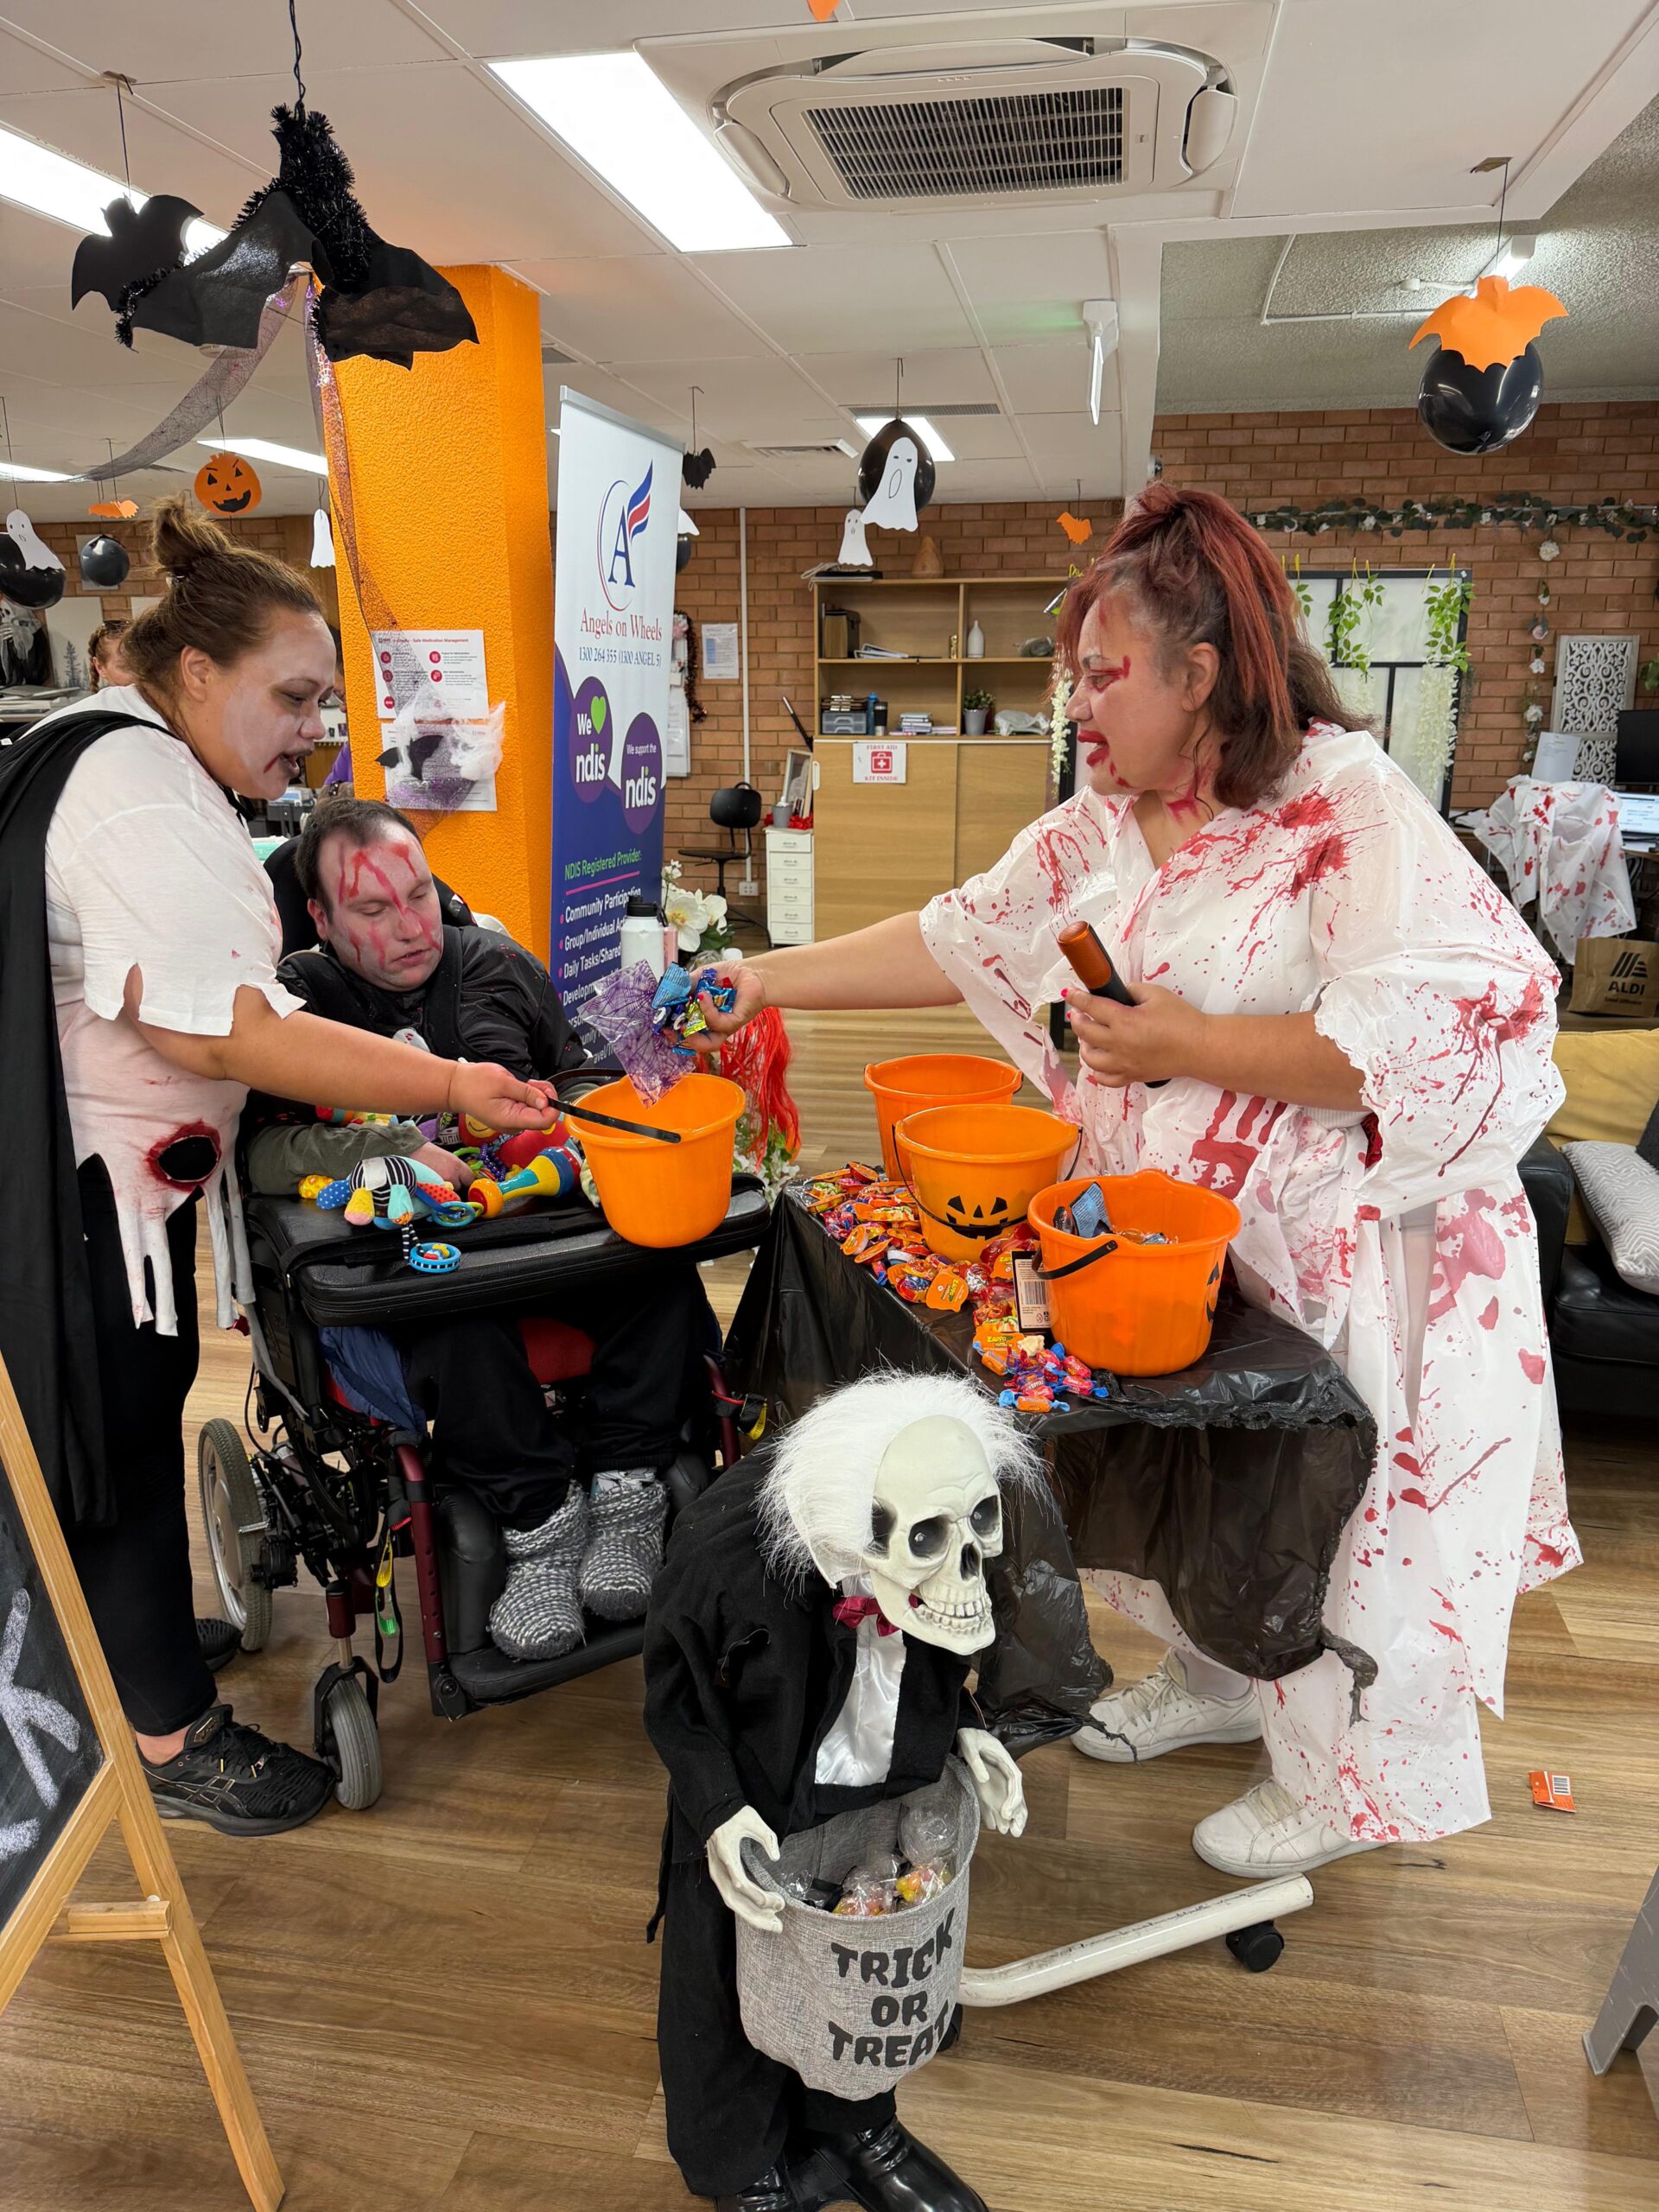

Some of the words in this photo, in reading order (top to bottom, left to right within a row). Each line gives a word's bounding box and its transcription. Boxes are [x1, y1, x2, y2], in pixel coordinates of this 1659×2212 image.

[581, 607, 613, 639] Angels
[615, 620, 627, 637] on
[630, 614, 663, 641] Wheels
[594, 647, 606, 663] 264
[634, 651, 655, 666] ANGEL
[577, 713, 592, 735] We
[575, 743, 606, 783] ndis
[626, 744, 634, 754] We
[635, 744, 649, 756] support
[625, 766, 657, 809] ndis
[565, 861, 581, 880] NDIS
[582, 853, 616, 877] Registered
[565, 897, 603, 923] Community
[564, 918, 615, 951] Group/Individual
[563, 958, 579, 979] Daily
[580, 942, 622, 971] Tasks/Shared
[1608, 981, 1645, 995] ALDI
[831, 1907, 956, 1987] TRICK
[871, 1991, 928, 2027] OR
[829, 2000, 949, 2068] TREAT
